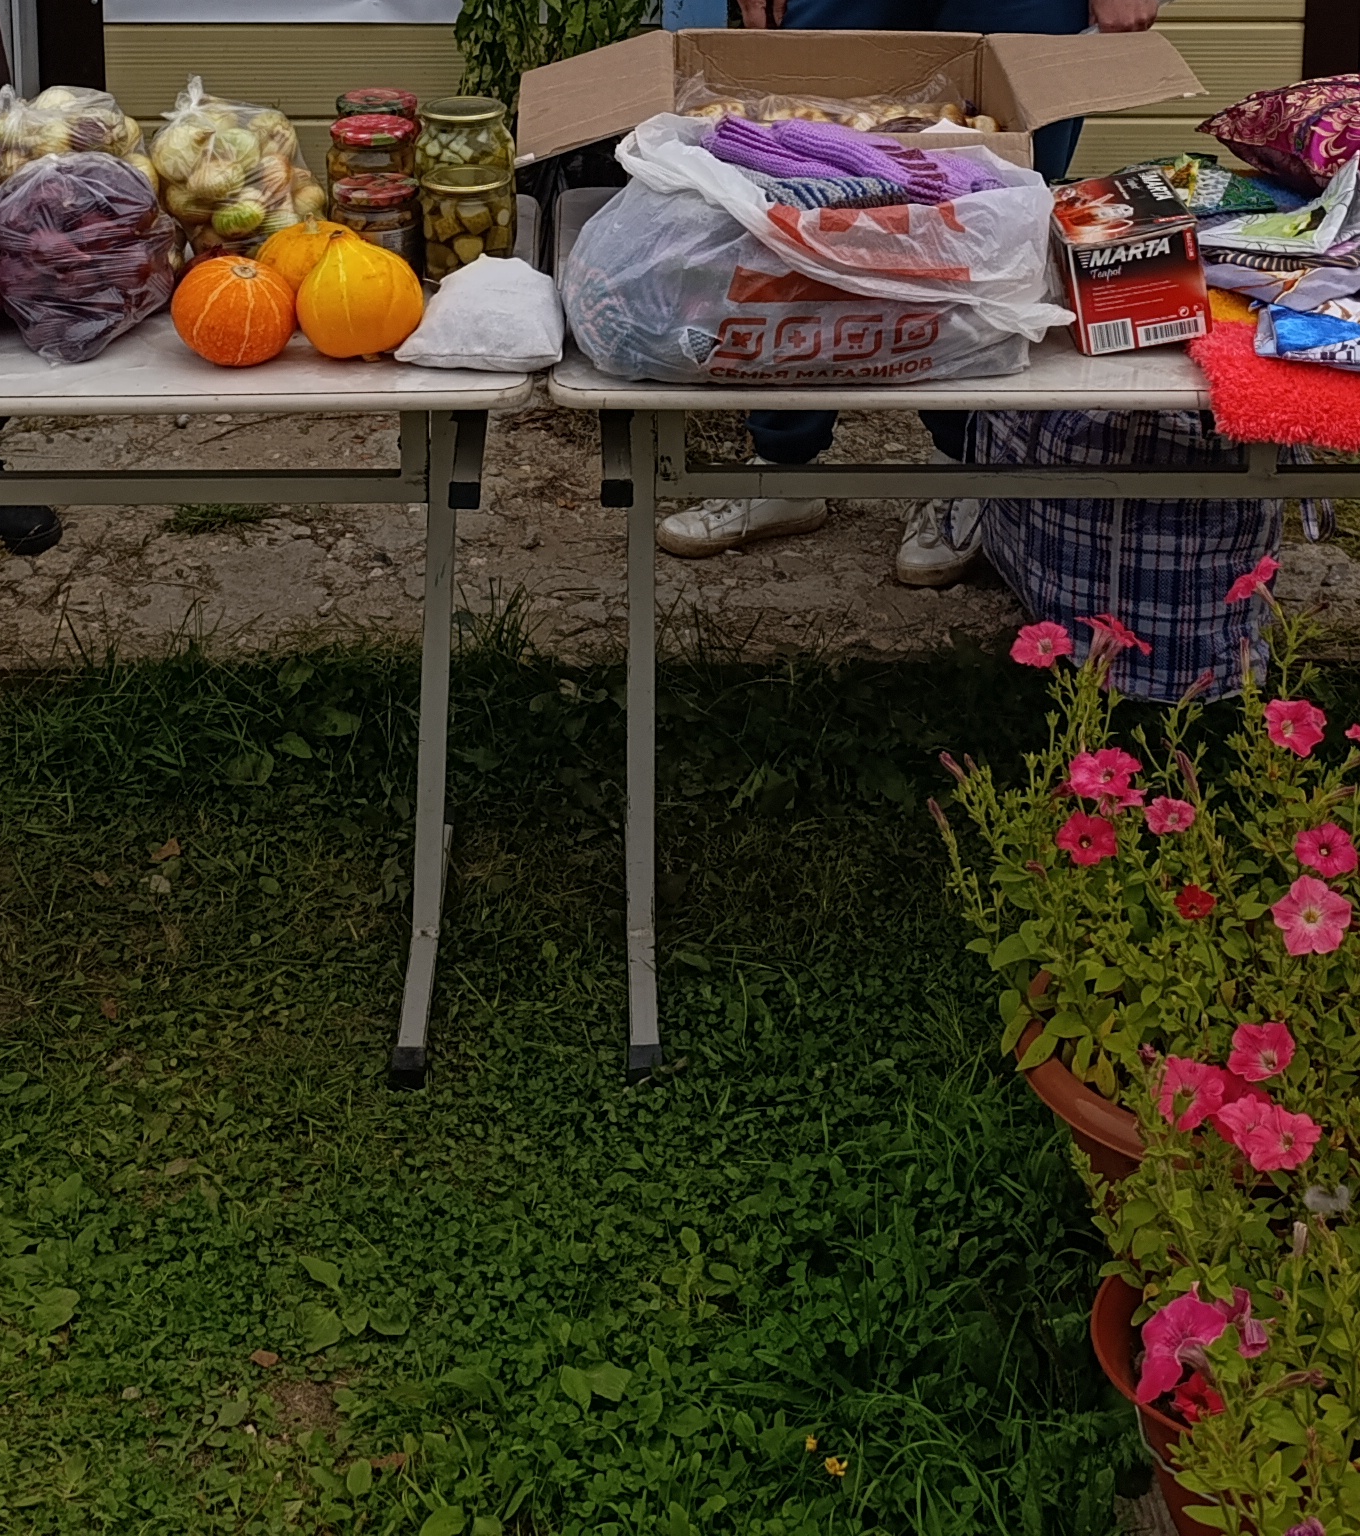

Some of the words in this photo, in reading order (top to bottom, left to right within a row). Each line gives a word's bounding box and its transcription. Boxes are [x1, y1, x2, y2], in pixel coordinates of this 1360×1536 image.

[1089, 237, 1171, 268] MARTA
[708, 366, 789, 380] СЕМЬЯ
[795, 356, 934, 379] МАГАЗИНОВ
